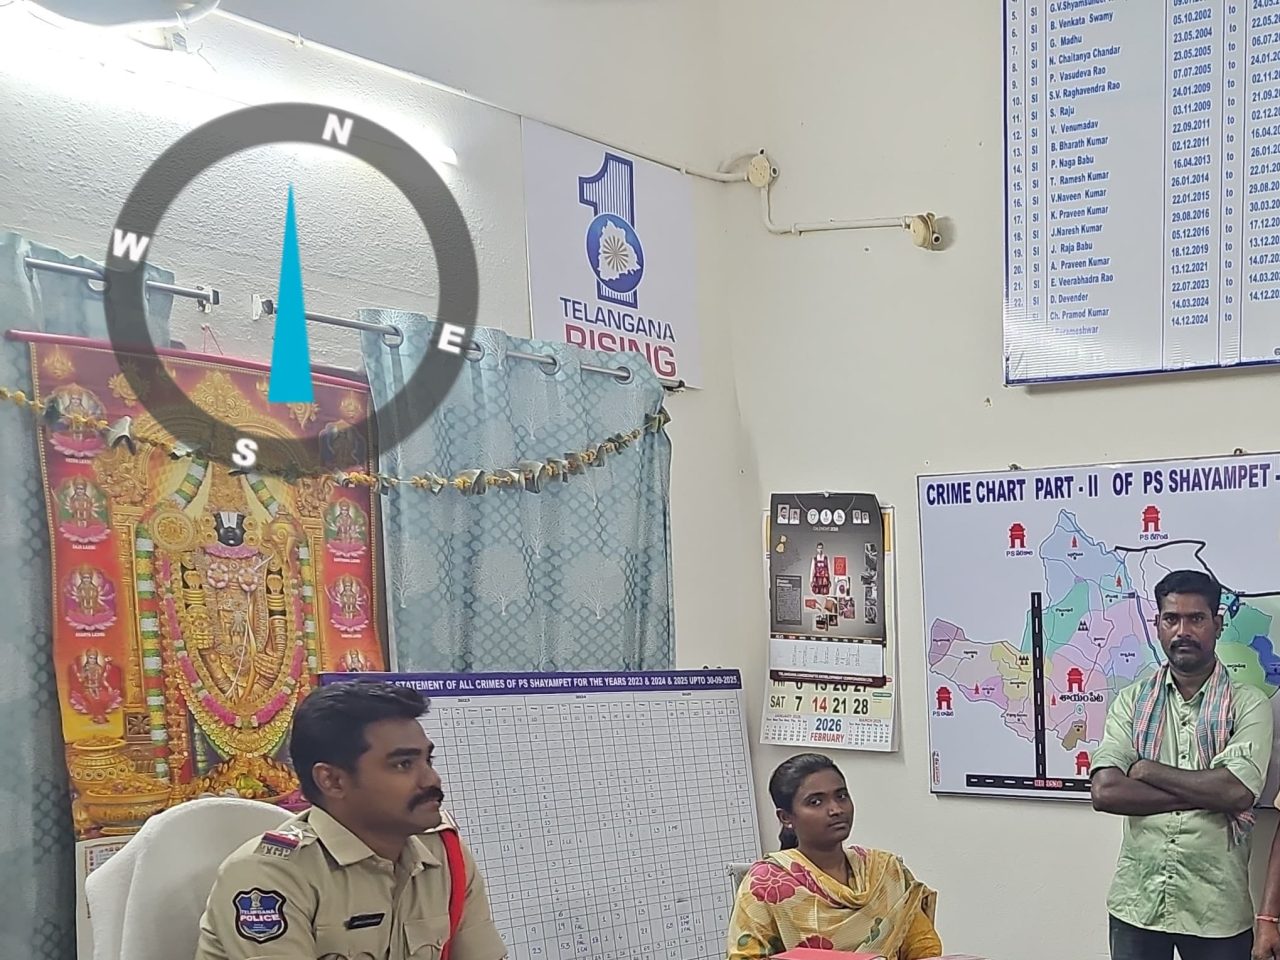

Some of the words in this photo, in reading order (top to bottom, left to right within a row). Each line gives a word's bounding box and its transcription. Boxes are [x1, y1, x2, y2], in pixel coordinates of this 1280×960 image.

[1059, 138, 1085, 151] Bharath
[1086, 136, 1109, 147] Kumar
[1227, 115, 1235, 124] to
[1050, 295, 1057, 304] D.
[1058, 292, 1089, 303] Devender
[1172, 279, 1210, 292] 22.07.2023
[1226, 278, 1233, 286] to
[1050, 310, 1060, 320] Ch.
[1088, 308, 1109, 318] Kumar
[1172, 297, 1210, 309] 14.03.2024
[1226, 295, 1233, 304] to
[560, 297, 676, 342] TELANGANA
[1171, 313, 1209, 326] 14.12.2024
[1224, 312, 1232, 321] to
[926, 482, 972, 506] CRIME
[976, 479, 1025, 504] CHART
[1036, 477, 1074, 501] PART
[1088, 475, 1098, 498] II
[1113, 473, 1133, 496] OF
[1144, 471, 1165, 494] PS
[1169, 464, 1271, 493] SHAYAMPET
[446, 680, 458, 690] OF
[460, 679, 475, 690] ALL
[475, 679, 506, 690] CRIMES
[507, 678, 517, 689] OF
[519, 678, 529, 688] PS
[530, 677, 573, 688] SHAYAMPET
[574, 677, 589, 687] FOR
[590, 677, 604, 687] THE
[604, 677, 627, 686] YEARS
[689, 676, 706, 685] UPTO
[770, 695, 786, 709] SAT
[795, 696, 803, 711] 7
[812, 696, 828, 713] 14
[833, 697, 847, 714] 21
[853, 698, 868, 715] 28
[815, 718, 842, 732] 2026
[810, 732, 845, 744] FEBRUARY
[240, 914, 280, 922] POLICE
